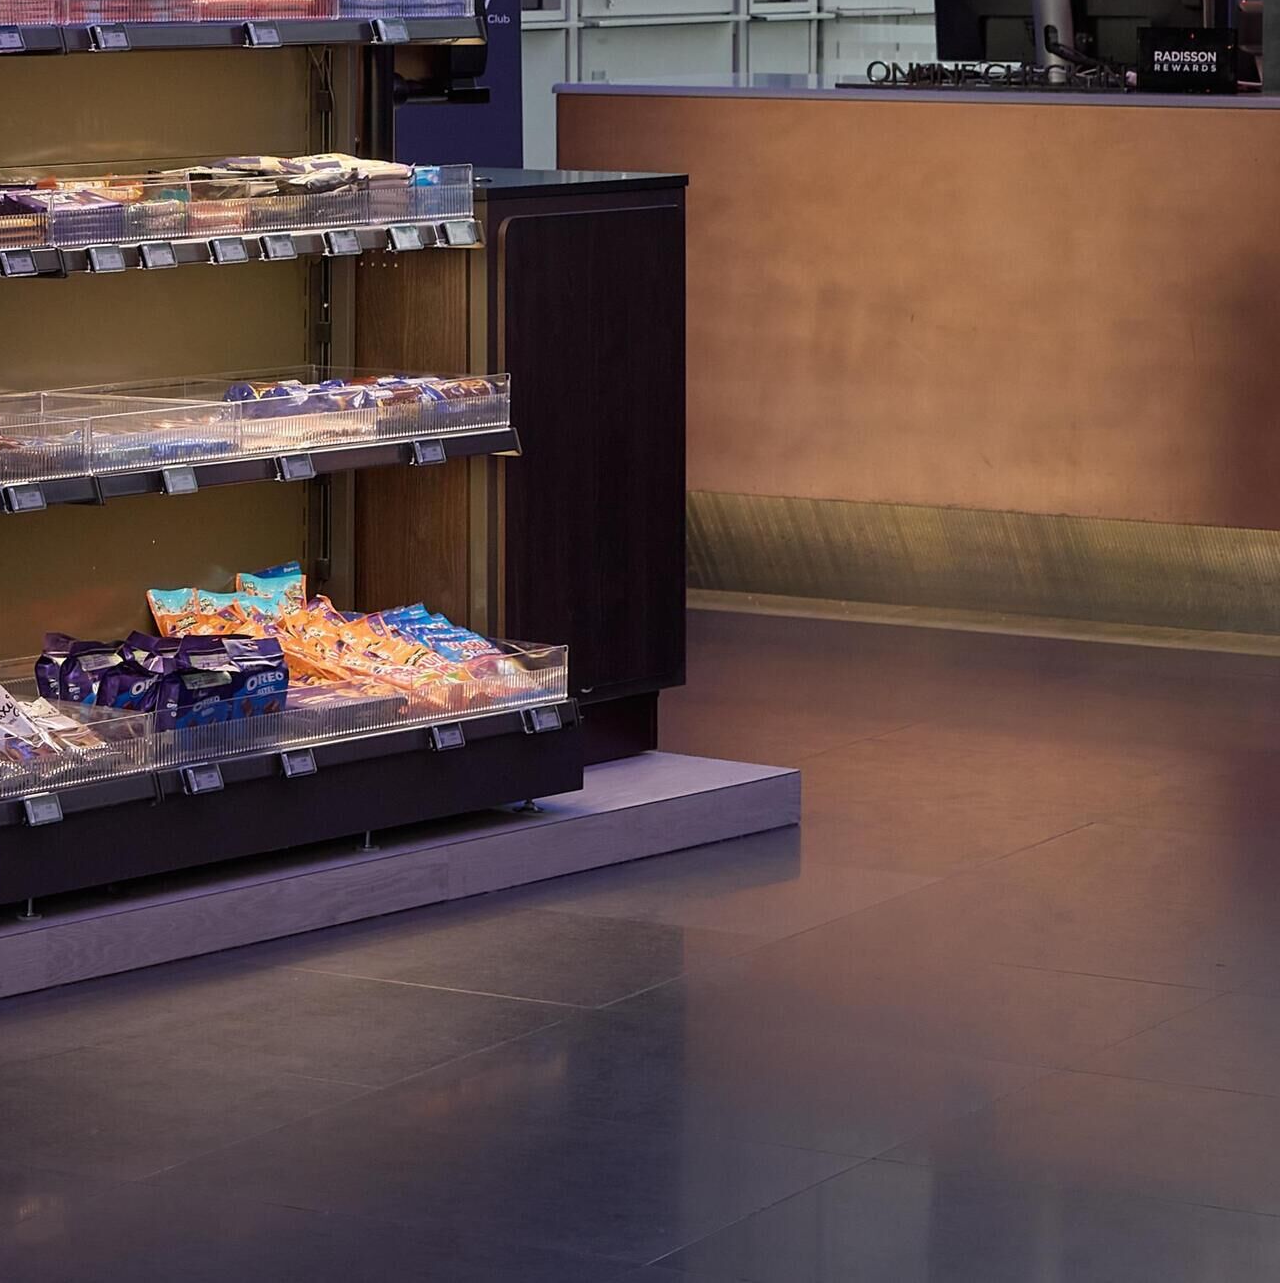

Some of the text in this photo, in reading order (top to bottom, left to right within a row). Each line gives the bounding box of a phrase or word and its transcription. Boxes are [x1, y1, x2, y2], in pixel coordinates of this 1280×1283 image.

[487, 14, 511, 24] Club
[1154, 50, 1217, 63] RADISSON
[1154, 63, 1217, 73] REWARDS
[246, 671, 285, 691] OREO
